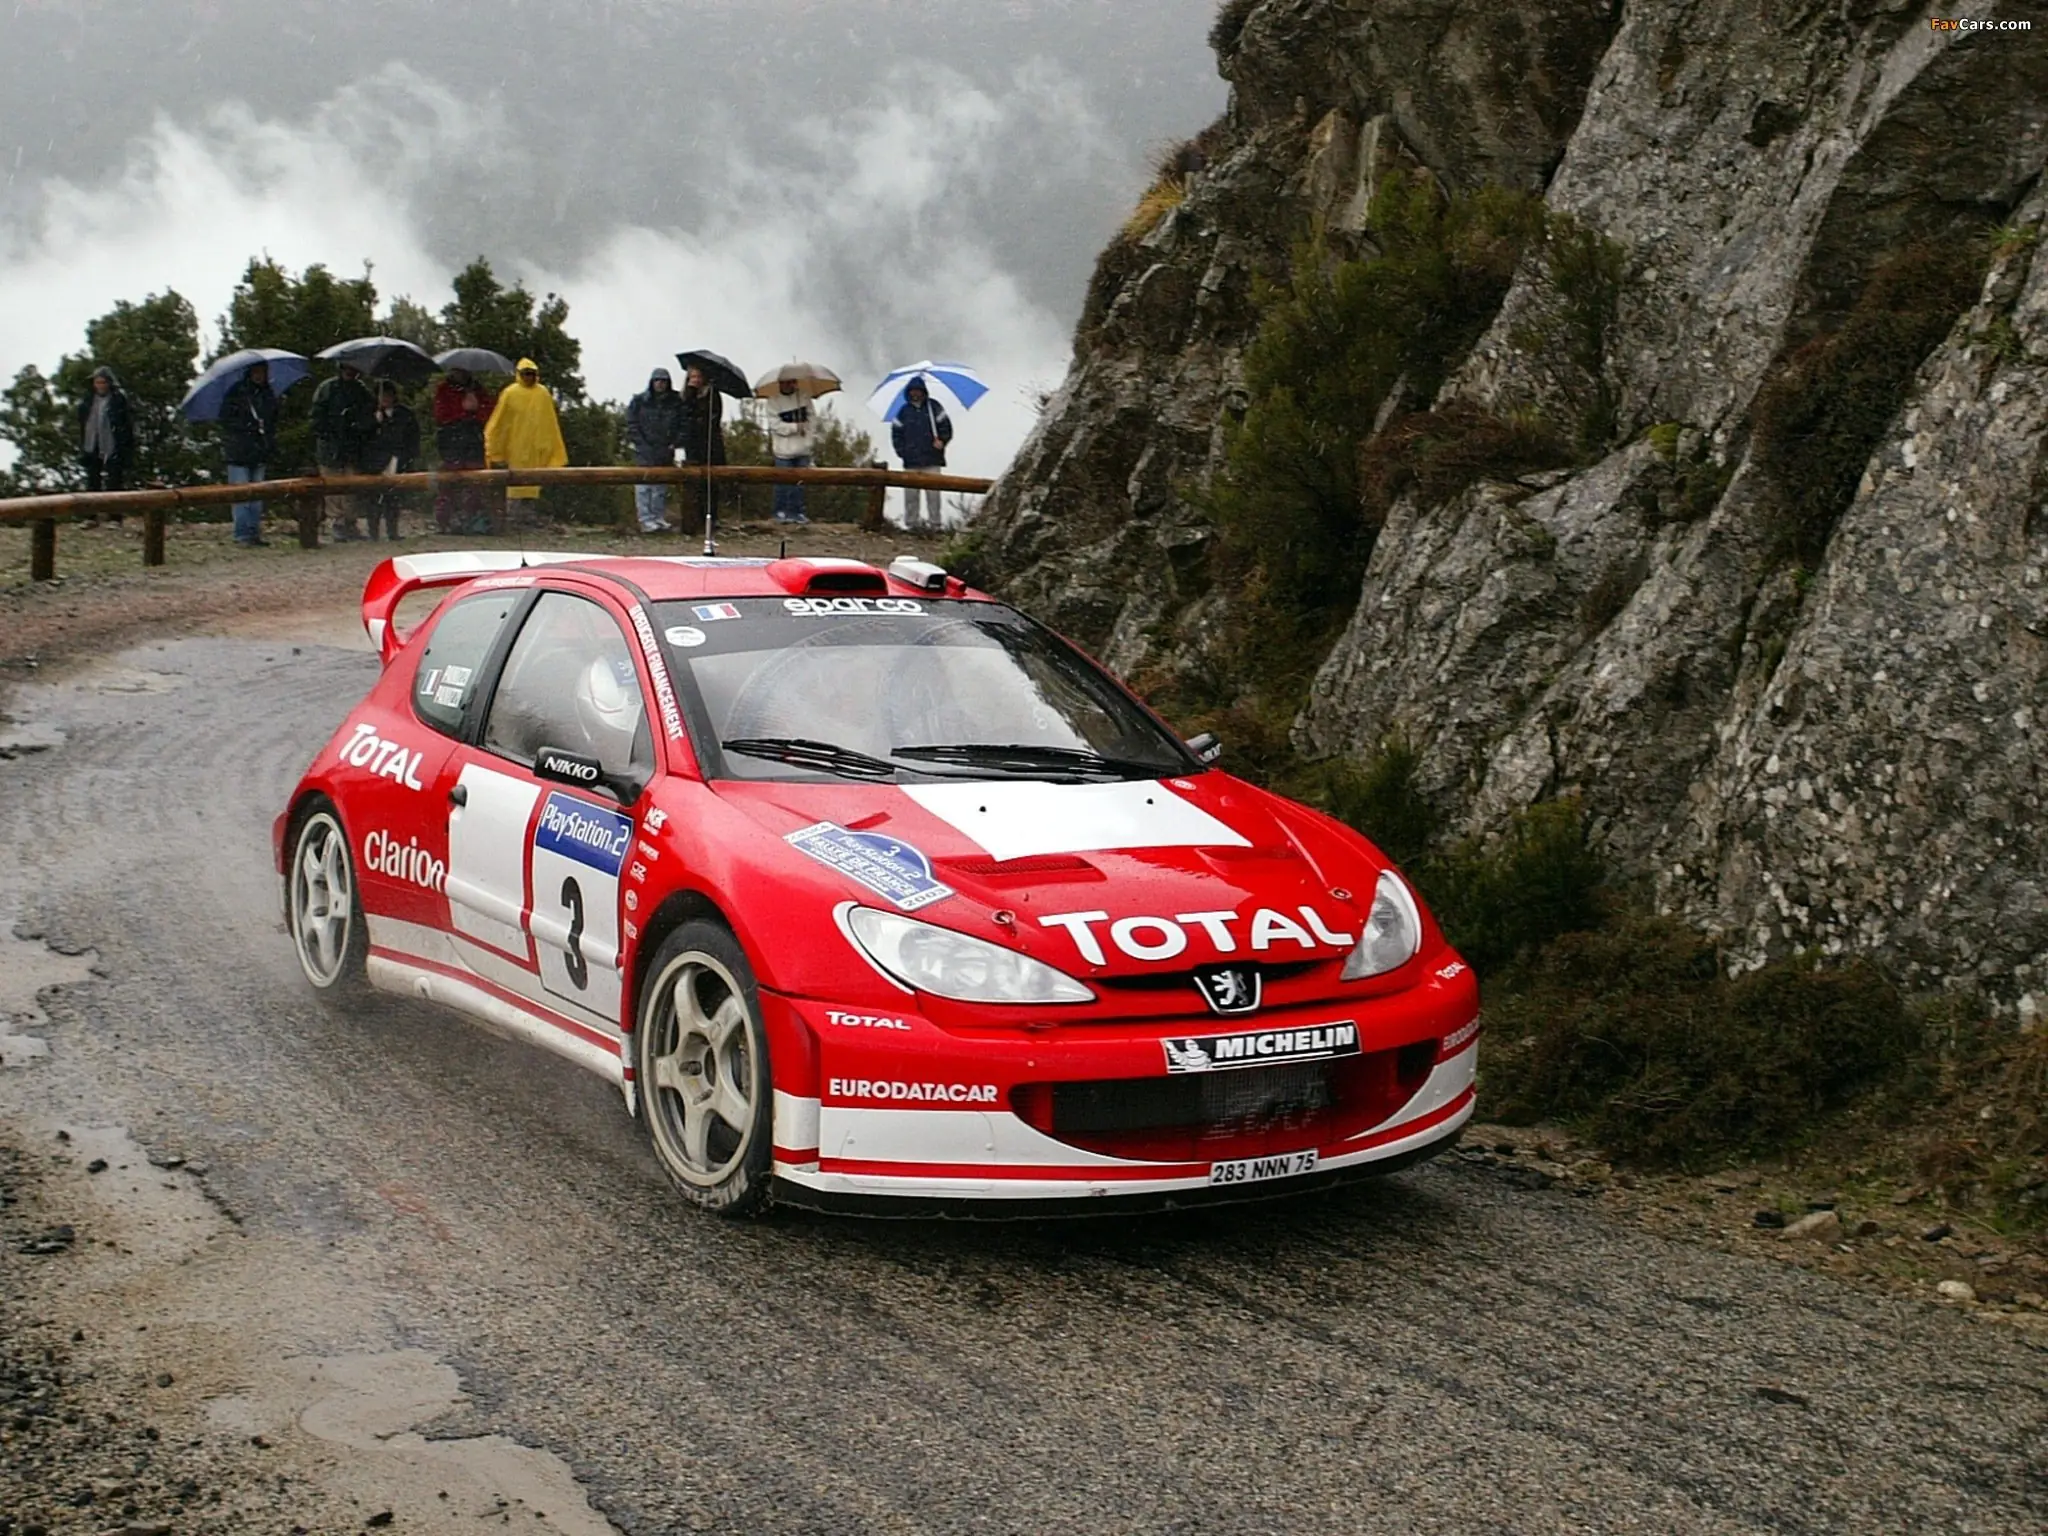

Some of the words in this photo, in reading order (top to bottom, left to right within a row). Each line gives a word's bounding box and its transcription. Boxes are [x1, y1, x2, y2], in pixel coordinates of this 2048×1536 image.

[783, 597, 922, 616] sparco
[339, 723, 423, 791] TOTAL
[544, 756, 598, 781] NIKKO
[540, 803, 612, 850] PlayStation
[363, 829, 445, 892] Clarion
[883, 845, 900, 857] 3
[561, 876, 588, 990] 3
[1037, 906, 1354, 966] TOTAL
[826, 1011, 911, 1030] TOTAL
[1215, 1026, 1354, 1059] MICHELIN
[828, 1078, 998, 1102] EURODATACAR
[1213, 1163, 1246, 1183] 283
[1252, 1157, 1290, 1178] NNN
[1296, 1152, 1315, 1172] 75
